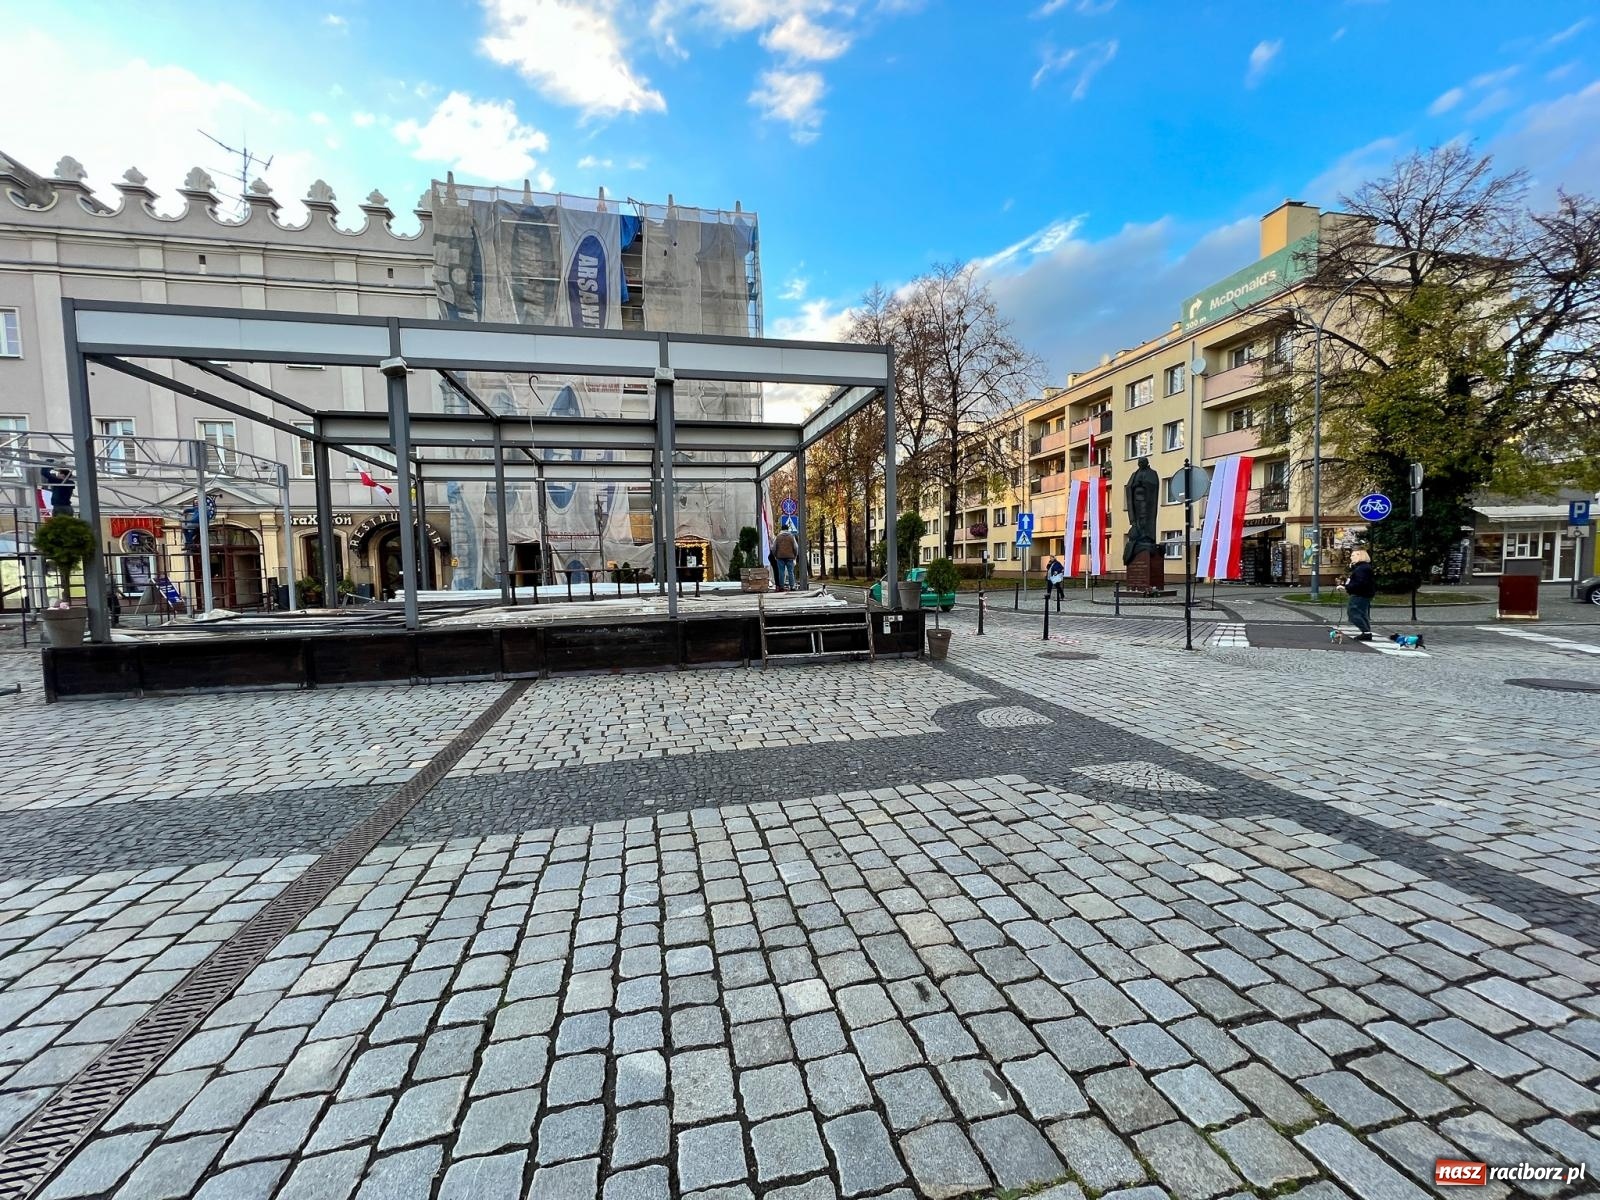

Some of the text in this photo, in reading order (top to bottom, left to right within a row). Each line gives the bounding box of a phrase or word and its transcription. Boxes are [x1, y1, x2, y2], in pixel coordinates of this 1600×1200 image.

[1209, 270, 1277, 311] McDonald's
[1573, 502, 1586, 518] P
[350, 512, 441, 547] RESTAUACJA
